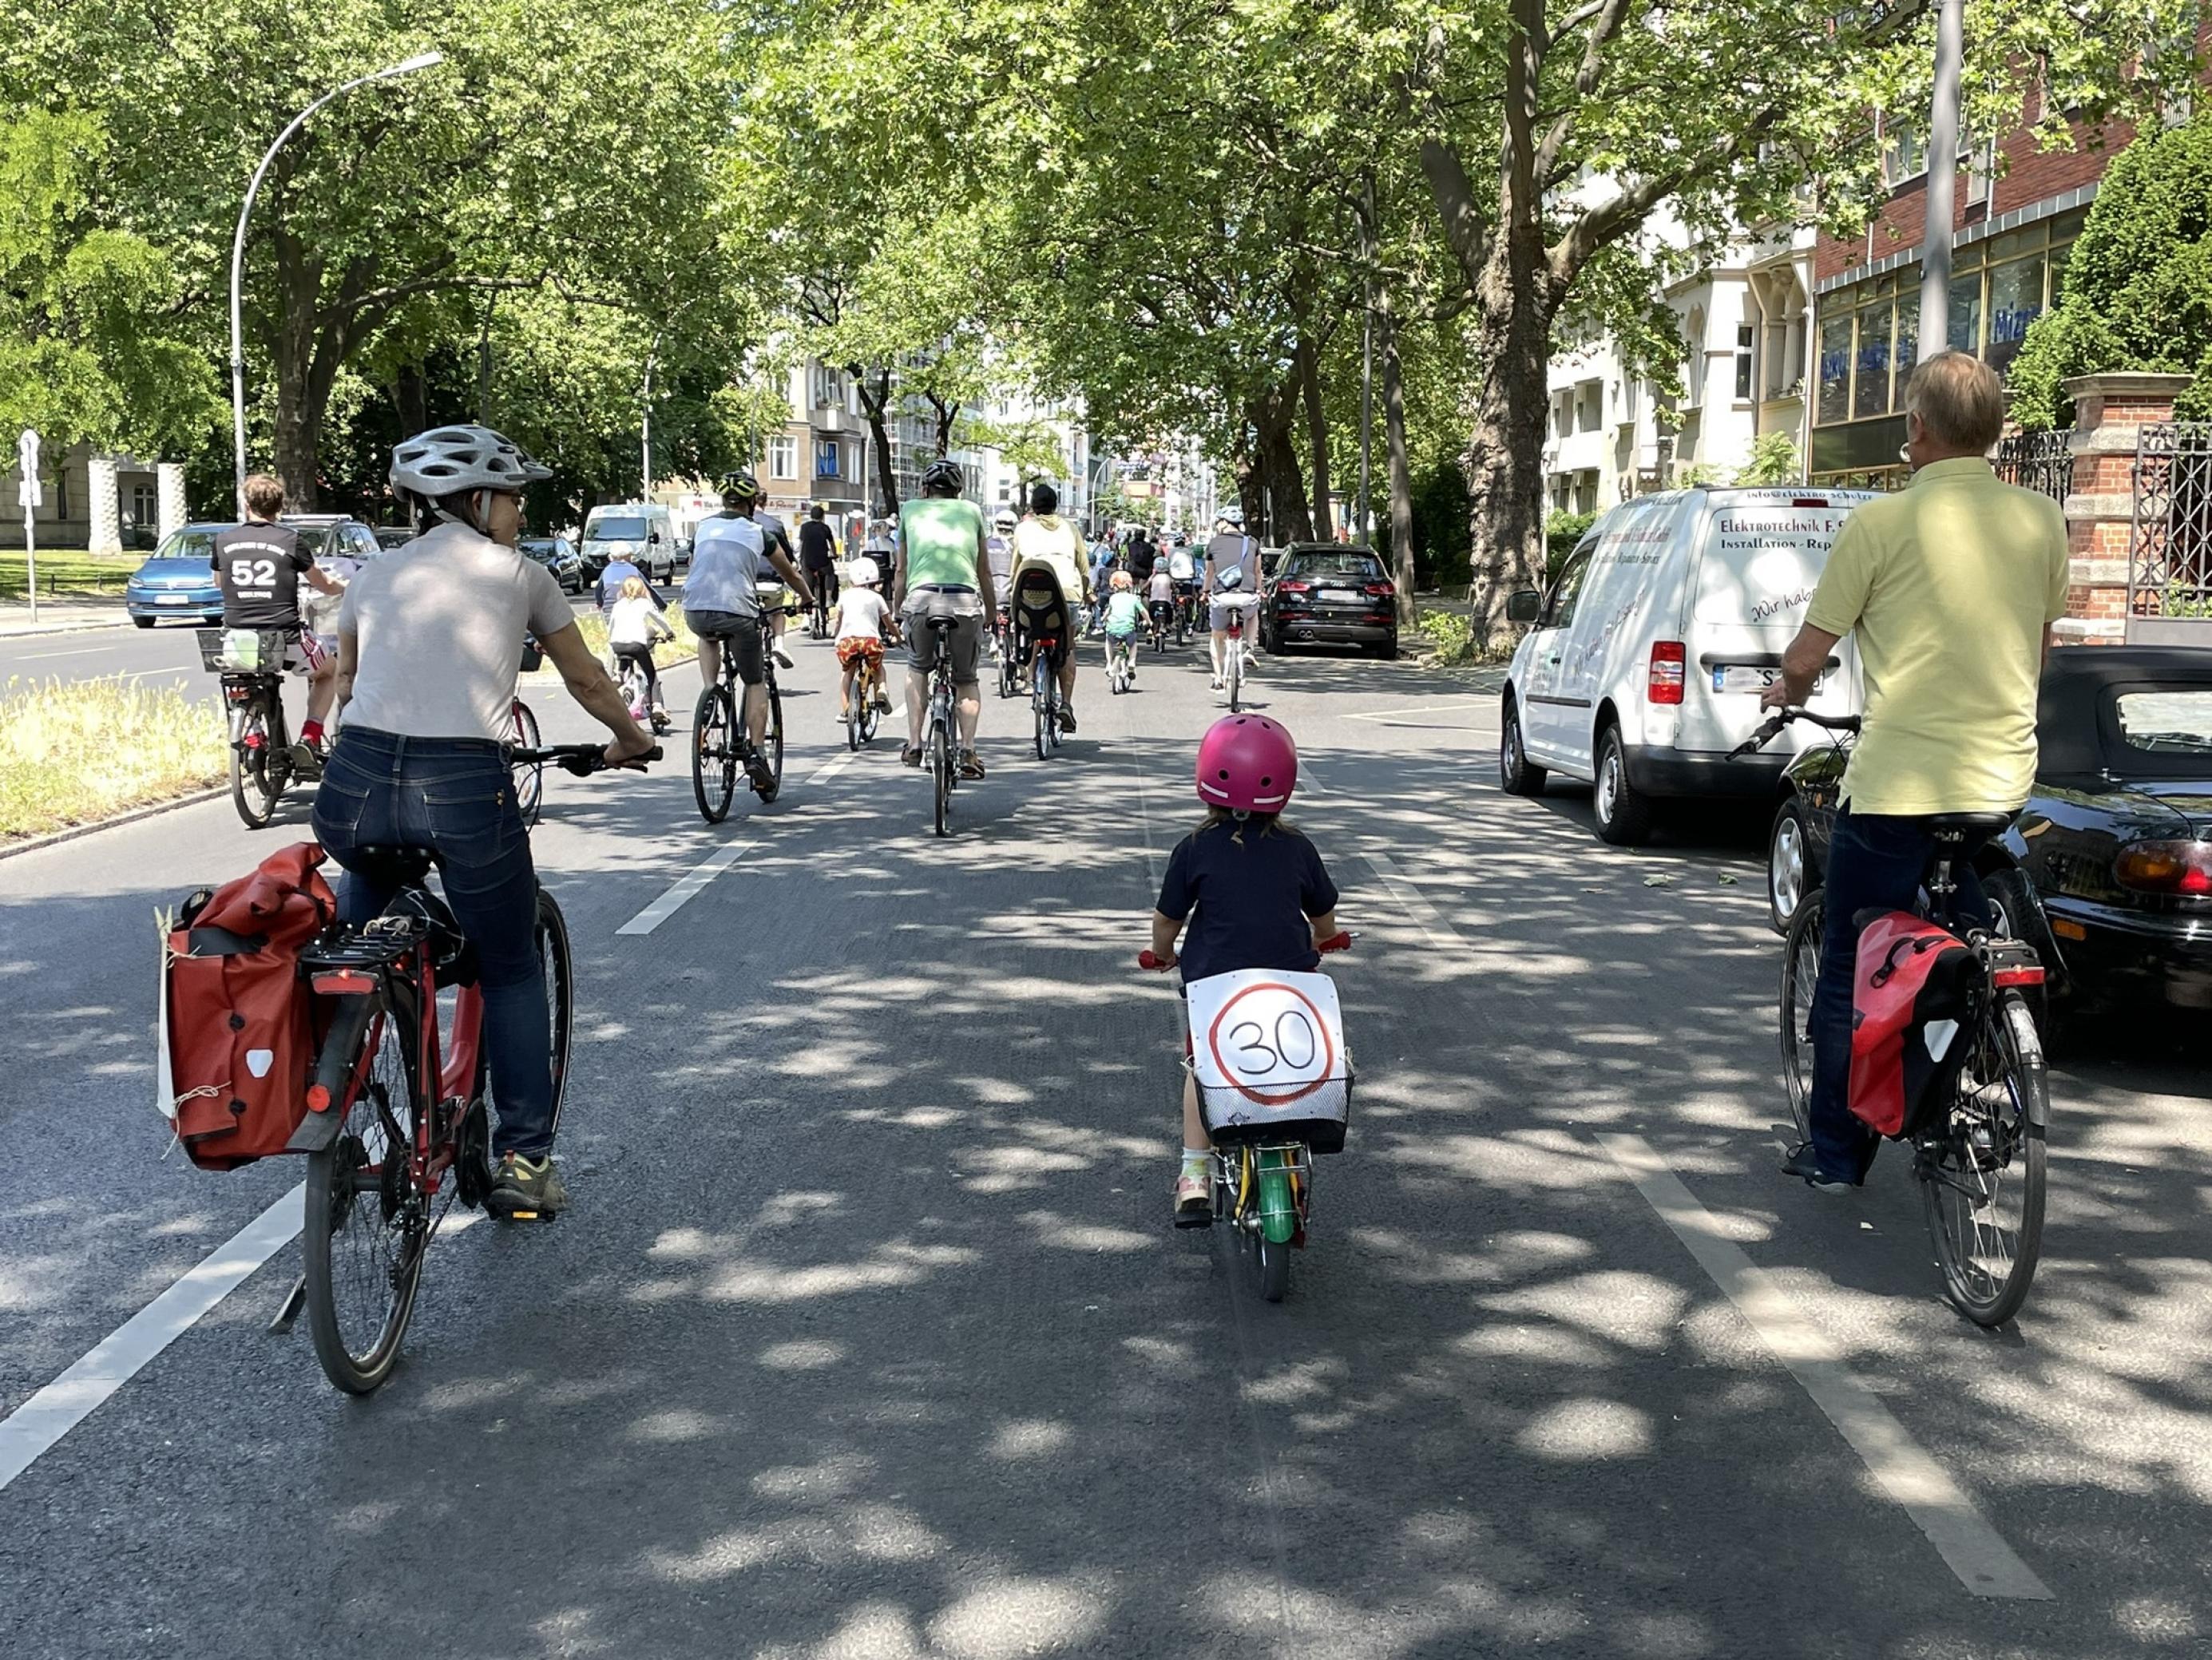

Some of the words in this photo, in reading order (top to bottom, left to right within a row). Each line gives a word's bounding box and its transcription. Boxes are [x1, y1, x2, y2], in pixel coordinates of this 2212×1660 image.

[1807, 539, 1833, 551] Rep
[232, 560, 276, 586] 52
[1229, 1010, 1315, 1076] 30
